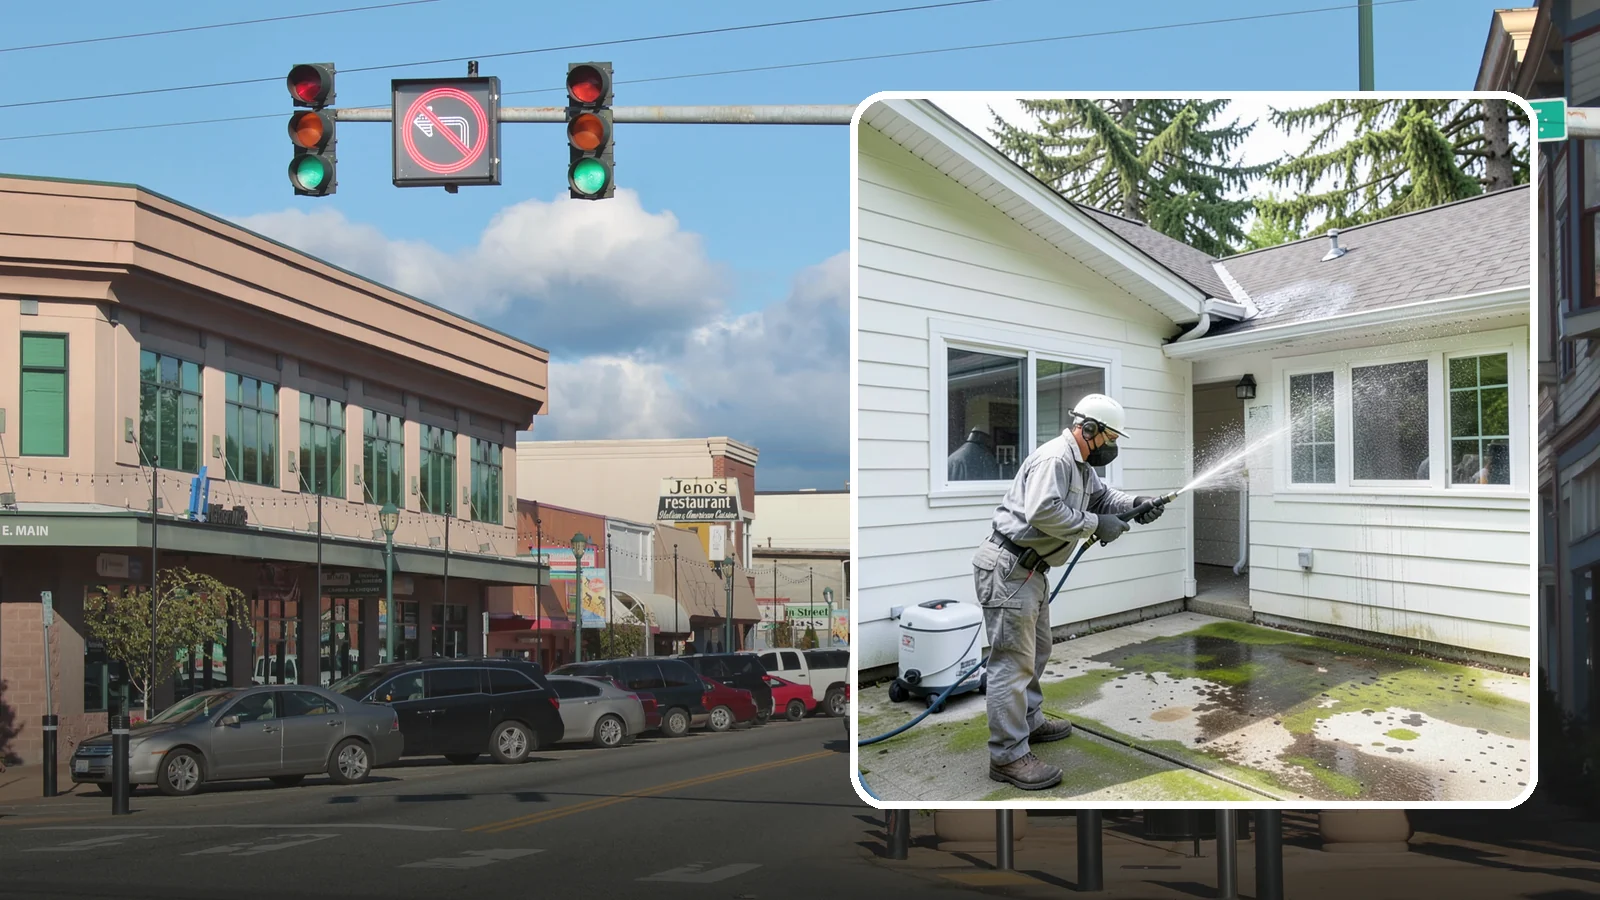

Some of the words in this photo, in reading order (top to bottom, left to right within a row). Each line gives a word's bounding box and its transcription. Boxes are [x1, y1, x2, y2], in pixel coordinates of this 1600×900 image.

[670, 480, 727, 494] Jeno's
[665, 496, 731, 509] restaurant
[658, 509, 682, 519] Italian
[686, 509, 714, 519] American
[715, 509, 737, 519] Cuisine
[2, 525, 13, 536] E.
[15, 525, 49, 536] MAIN
[797, 607, 829, 617] Street
